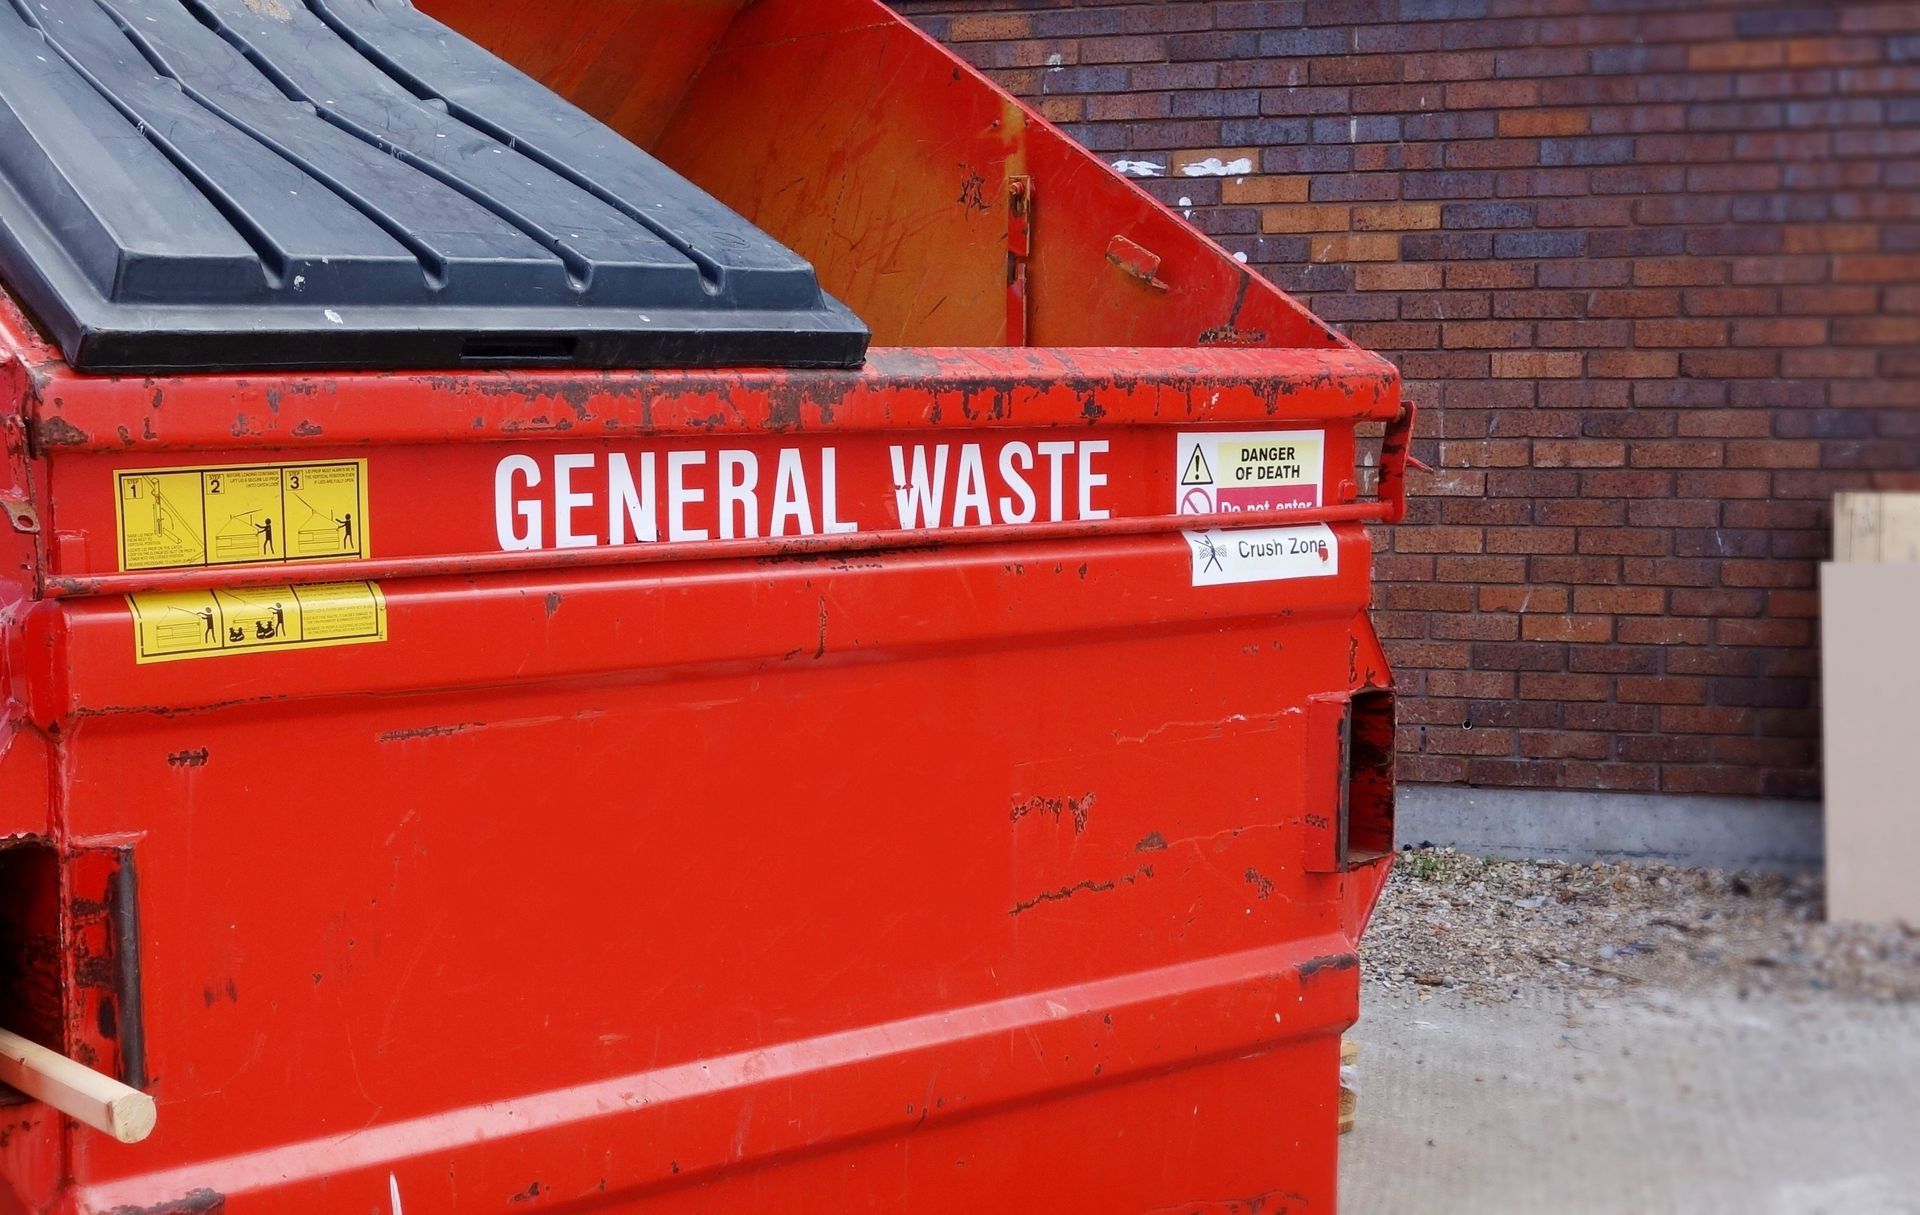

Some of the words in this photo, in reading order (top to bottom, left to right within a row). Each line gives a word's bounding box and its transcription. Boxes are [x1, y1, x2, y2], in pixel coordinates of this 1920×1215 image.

[1241, 446, 1295, 462] DANGER
[1235, 466, 1253, 480] OF
[1257, 464, 1300, 480] DEATH
[210, 479, 220, 493] 2
[290, 476, 299, 489] 3
[130, 484, 137, 498] 1
[495, 447, 858, 551] GENERAL
[889, 439, 1111, 530] WASTE
[1238, 539, 1283, 558] Crush
[1288, 537, 1326, 555] Zone
